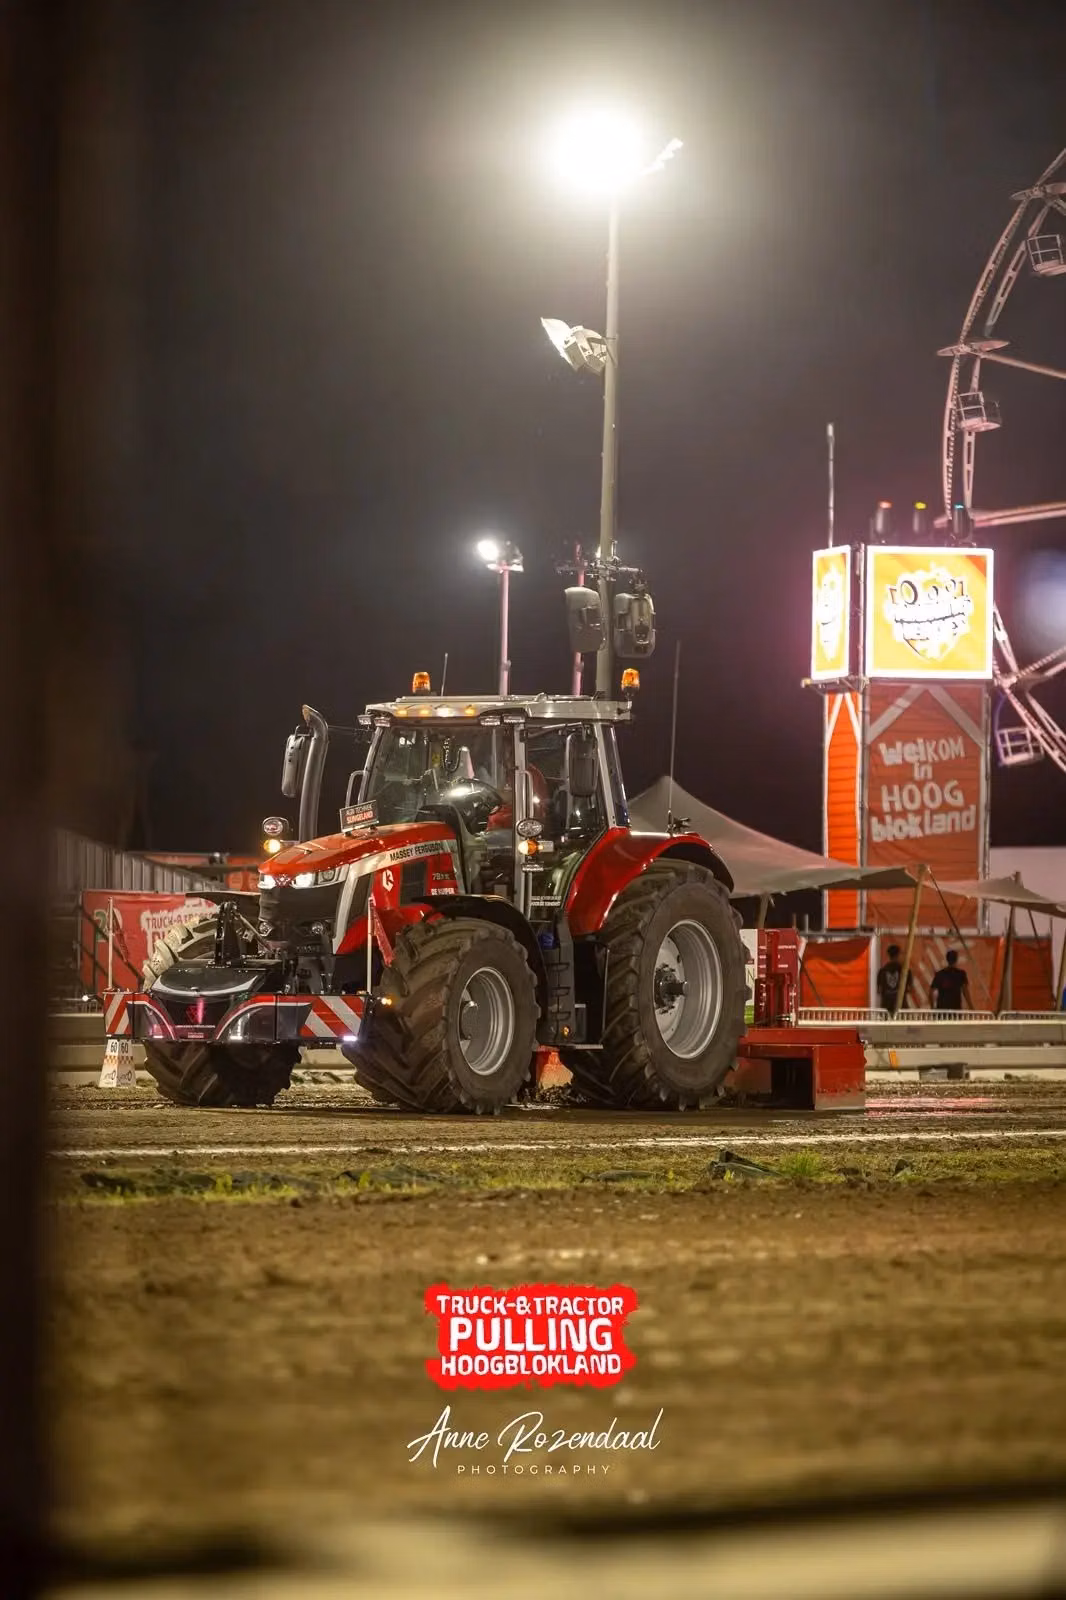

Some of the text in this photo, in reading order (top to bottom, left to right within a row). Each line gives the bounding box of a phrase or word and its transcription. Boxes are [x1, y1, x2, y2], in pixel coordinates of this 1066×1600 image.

[913, 762, 933, 781] in
[881, 780, 965, 813] HOOG
[389, 842, 444, 862] MASSEY FERGUSON
[110, 1041, 117, 1053] 60
[120, 1042, 129, 1054] 60
